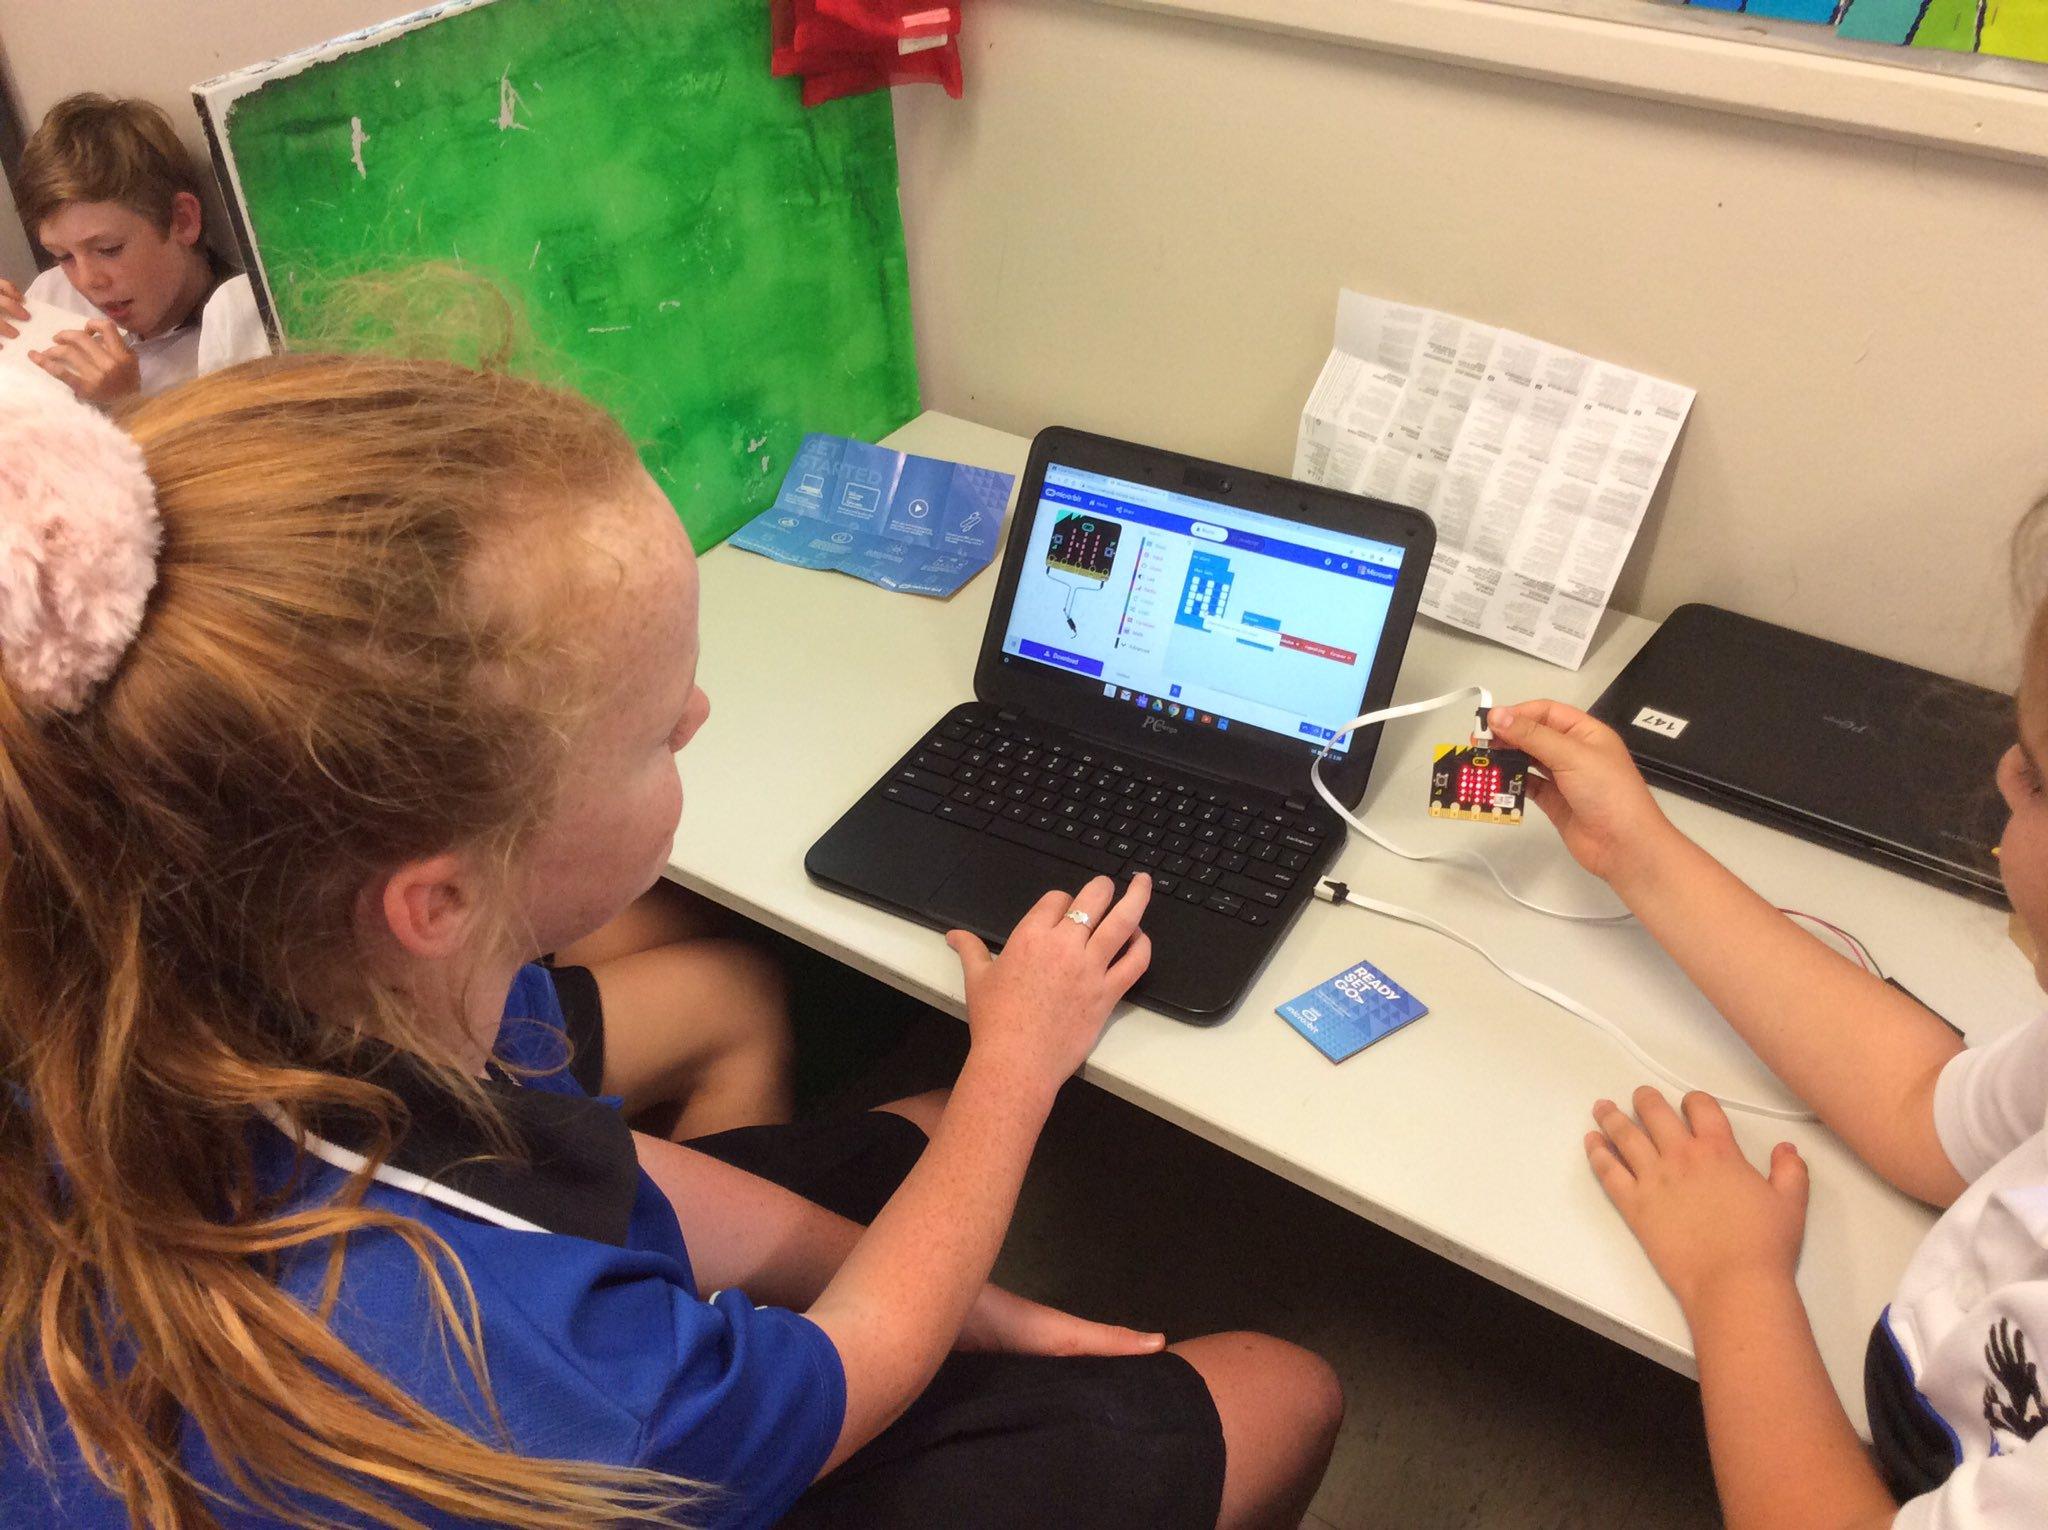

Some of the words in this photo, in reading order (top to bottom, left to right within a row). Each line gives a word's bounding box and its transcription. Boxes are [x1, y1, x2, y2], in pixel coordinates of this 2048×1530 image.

[1642, 716, 1674, 731] 147
[1344, 974, 1371, 992] SET
[1354, 966, 1401, 1000] READY
